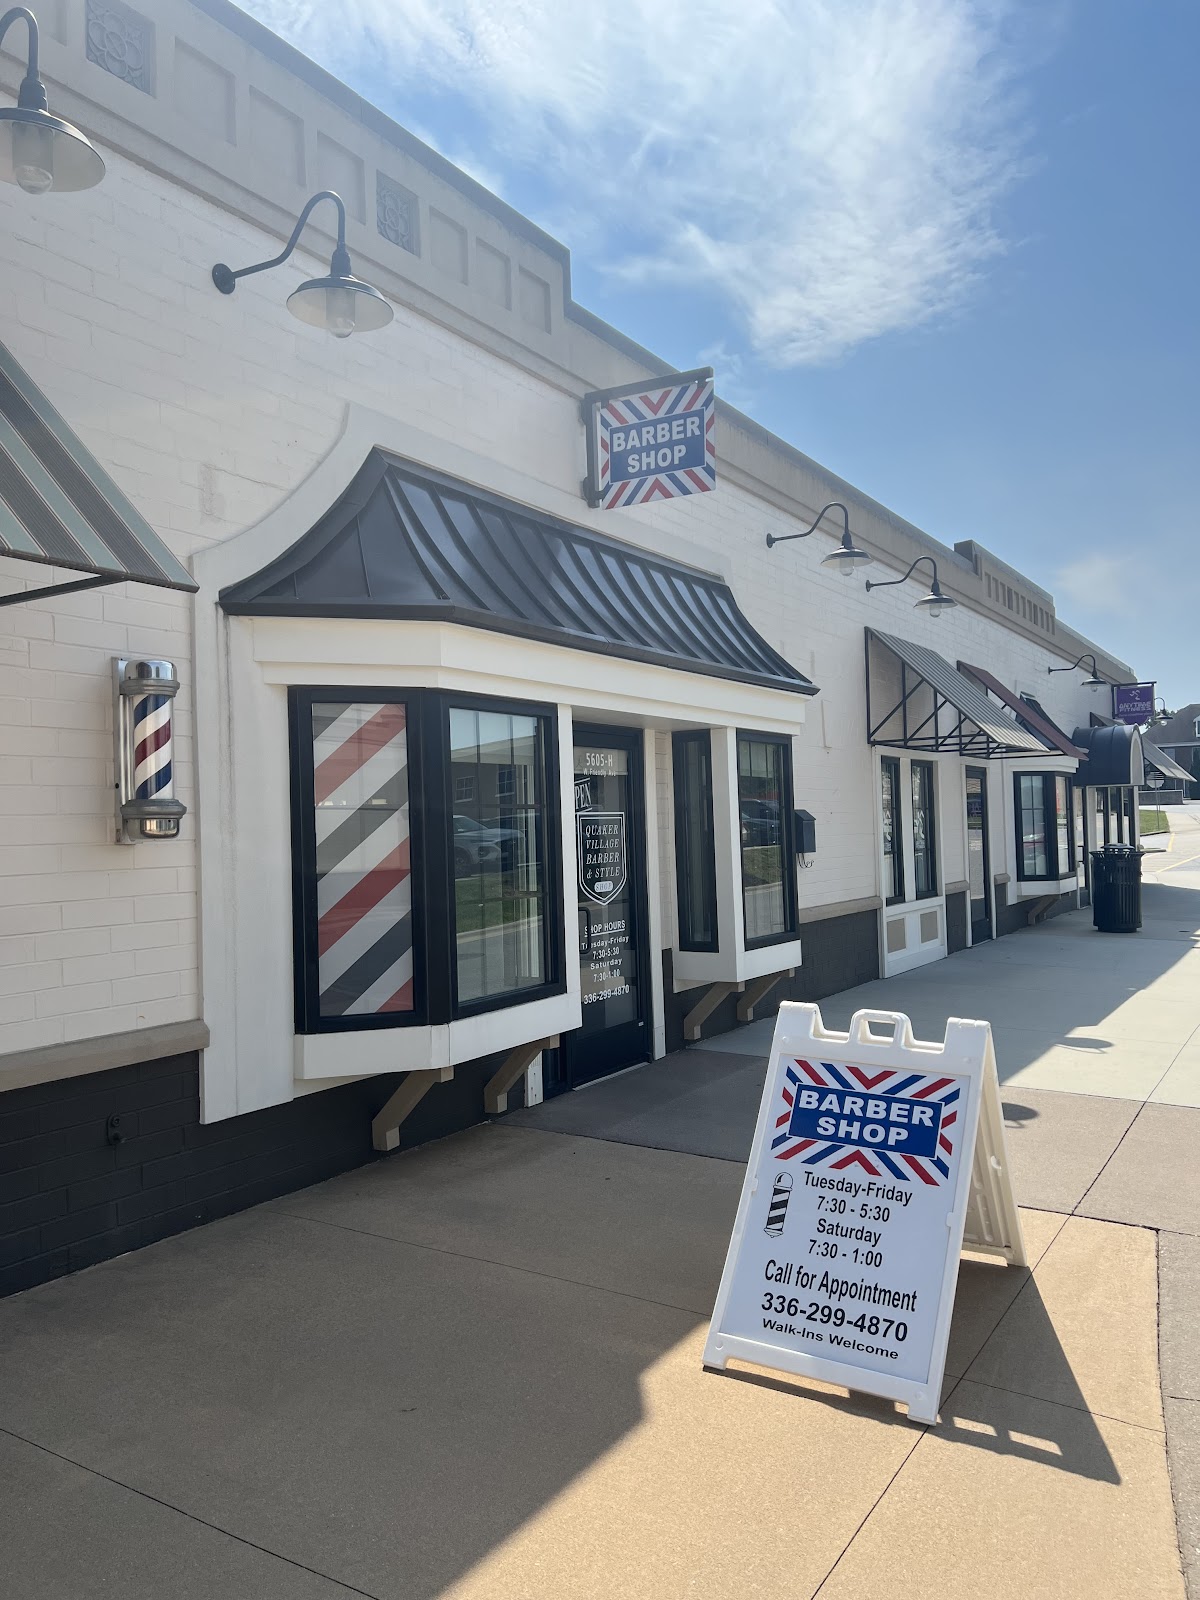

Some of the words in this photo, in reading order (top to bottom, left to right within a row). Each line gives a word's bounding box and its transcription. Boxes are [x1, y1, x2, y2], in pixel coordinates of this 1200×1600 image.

[613, 417, 700, 452] BARBER
[628, 445, 686, 473] SHOP
[1119, 701, 1152, 709] ANYTIME
[586, 753, 613, 767] 5605-H
[574, 782, 592, 810] PEN
[585, 824, 619, 838] QUAKER
[585, 838, 620, 850] VILLAGE
[586, 852, 620, 865] BARBER
[586, 868, 593, 879] &
[595, 866, 620, 878] STYLE
[595, 882, 612, 892] SHOP
[604, 920, 626, 931] HOURS
[590, 958, 623, 970] Saturday
[592, 946, 620, 960] 7:30-5:30
[583, 985, 630, 1005] 336-299-4870
[799, 1090, 934, 1127] BARBER
[816, 1117, 909, 1146] SHOP
[804, 1171, 913, 1207] Tuesday-Friday
[817, 1196, 847, 1214] 7:30
[859, 1203, 890, 1222] 5:30
[816, 1218, 882, 1248] Saturday
[808, 1239, 838, 1259] 7:30
[852, 1248, 883, 1268] 1:00
[764, 1259, 794, 1285] Call
[795, 1265, 817, 1289] for
[818, 1271, 918, 1312] Appointment
[761, 1292, 908, 1342] 336-299-4870
[762, 1318, 824, 1342] Walk-Ins
[829, 1333, 899, 1360] Welcome
